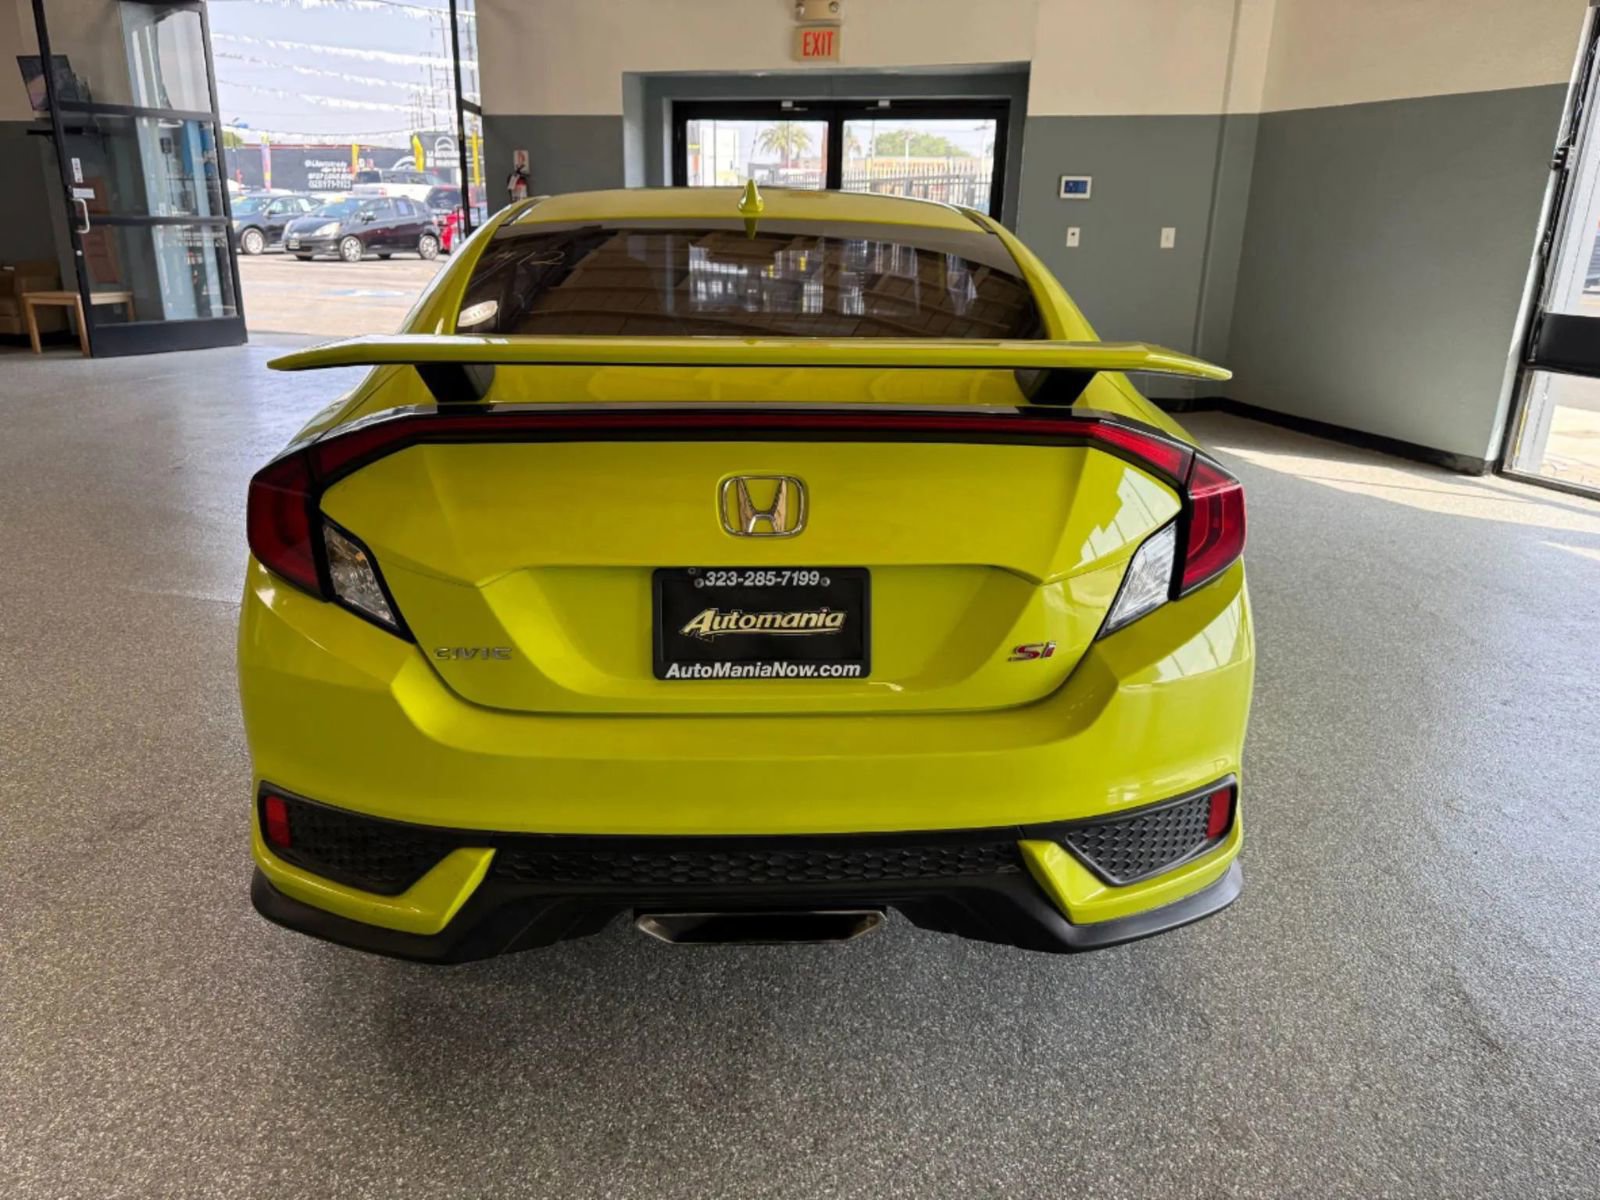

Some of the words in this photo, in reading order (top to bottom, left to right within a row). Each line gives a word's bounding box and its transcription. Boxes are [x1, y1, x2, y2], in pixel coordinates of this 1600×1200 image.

[803, 31, 833, 57] EXIT
[704, 571, 820, 587] 323-285-7199
[679, 607, 847, 638] Automania
[433, 646, 513, 661] CIVIC
[1007, 640, 1057, 662] Si
[665, 661, 862, 680] AutoManiaNow.com
